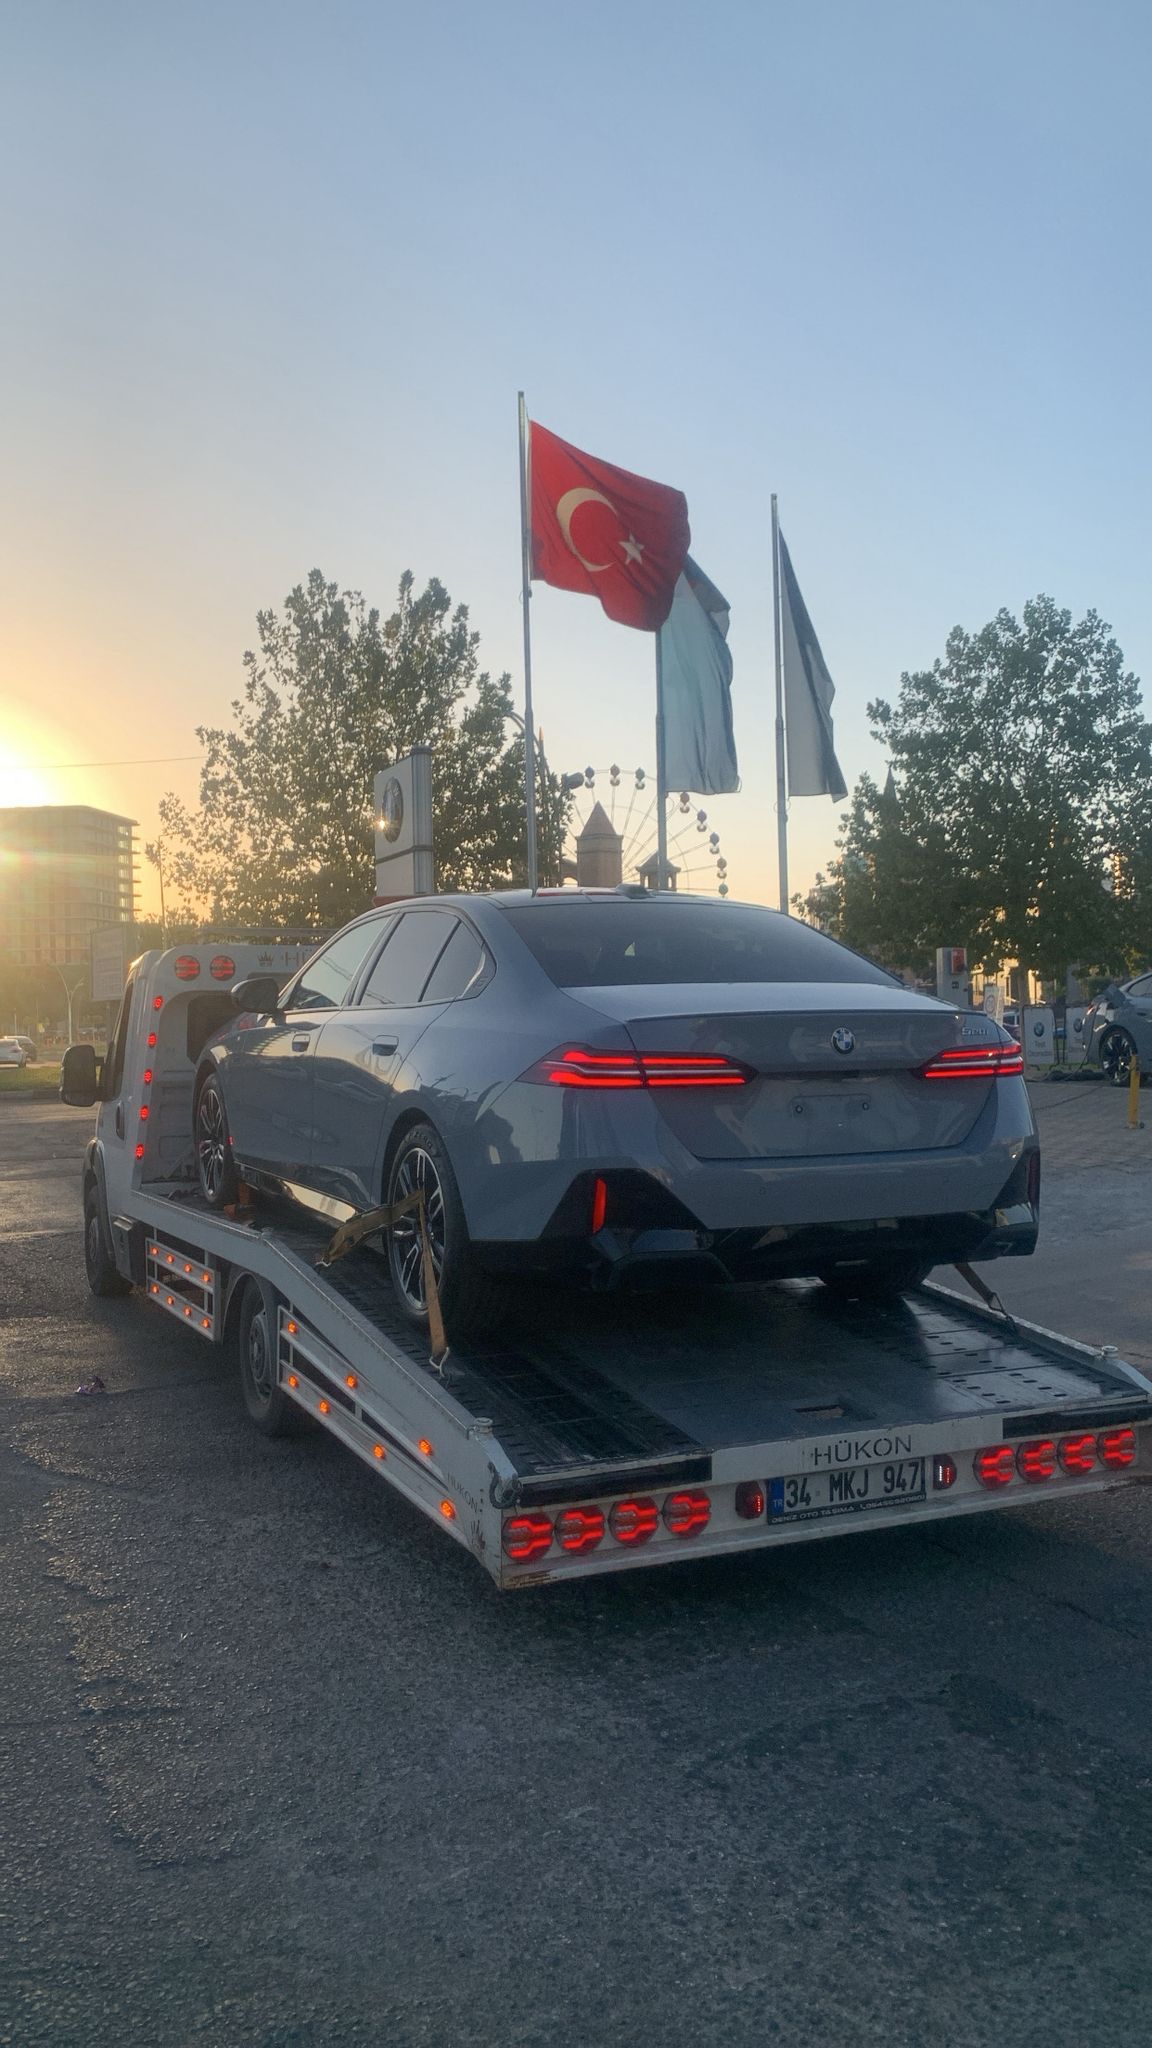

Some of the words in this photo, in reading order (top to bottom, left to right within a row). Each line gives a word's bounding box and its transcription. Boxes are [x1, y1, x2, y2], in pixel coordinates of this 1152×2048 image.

[814, 1435, 912, 1466] HÜKON
[785, 1477, 811, 1508] 34
[829, 1468, 869, 1503] MKJ
[883, 1461, 919, 1494] 947
[774, 1499, 784, 1509] TR
